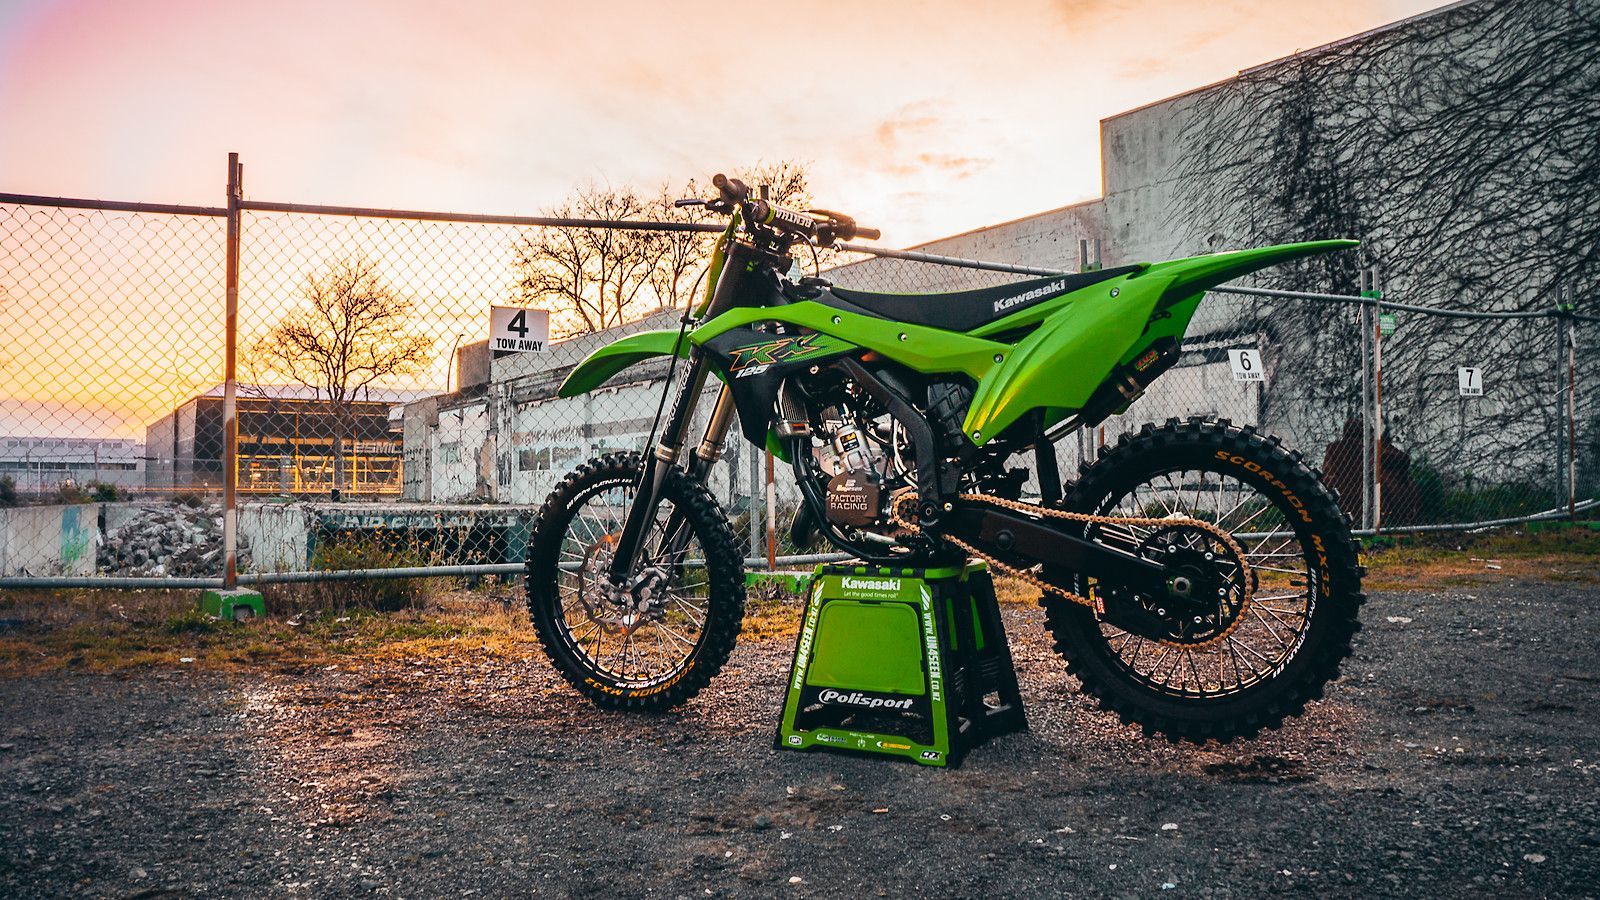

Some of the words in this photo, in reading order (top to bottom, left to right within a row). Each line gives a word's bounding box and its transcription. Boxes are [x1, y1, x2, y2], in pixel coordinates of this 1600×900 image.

[993, 280, 1066, 312] Kawasaki
[507, 310, 529, 338] 4
[496, 338, 517, 349] TOW
[518, 340, 543, 351] AWAY
[1240, 351, 1252, 371] 6
[735, 364, 771, 379] 125
[1465, 369, 1474, 387] 7
[830, 494, 868, 503] FACTORY
[1215, 450, 1312, 523] SCORPION
[1311, 534, 1330, 598] MX32
[841, 577, 901, 590] Kawasaki
[584, 678, 623, 696] MX32
[628, 659, 695, 697] SCORPION
[823, 687, 914, 709] Polisport
